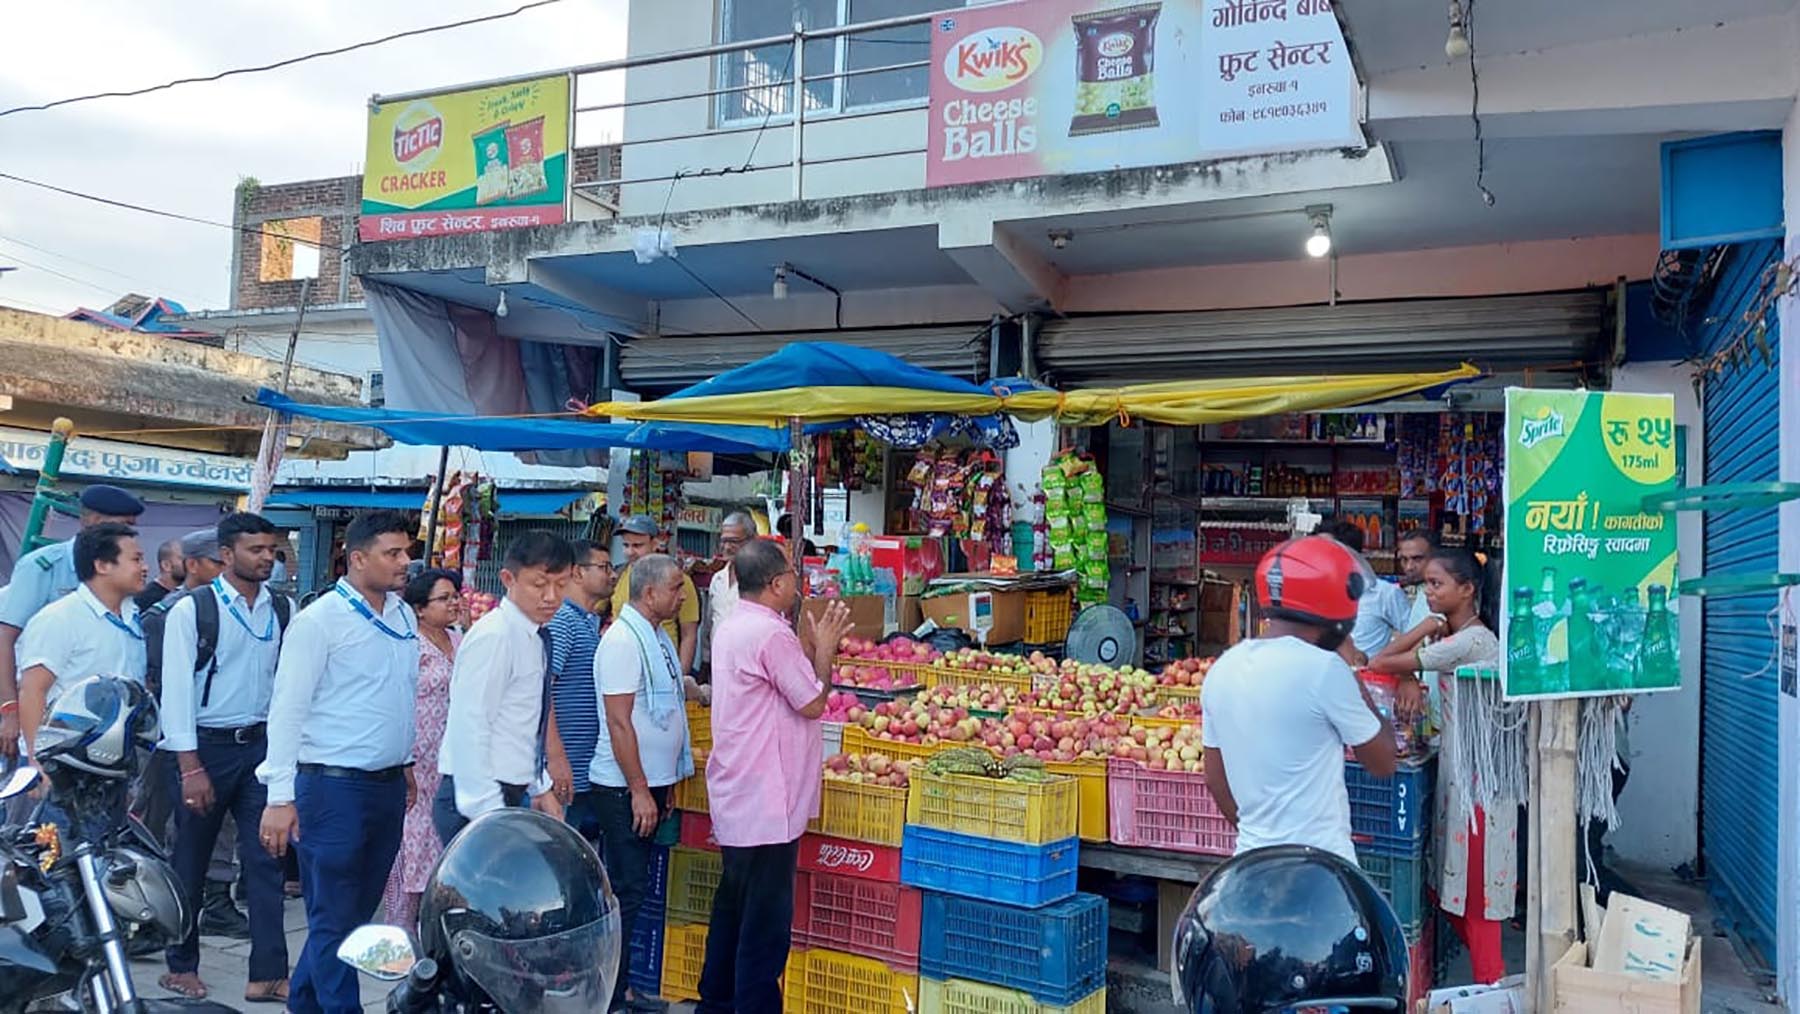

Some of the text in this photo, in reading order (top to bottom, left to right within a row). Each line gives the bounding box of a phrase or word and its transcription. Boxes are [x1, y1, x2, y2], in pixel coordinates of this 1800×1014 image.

[1268, 41, 1334, 70] सेन्टर
[1097, 64, 1133, 80] Balls
[943, 97, 1037, 126] Cheese
[942, 121, 1037, 161] Balls
[380, 171, 447, 193] CRACKER
[1522, 415, 1562, 443] Sprite
[1622, 454, 1659, 468] 175ml
[1525, 491, 1588, 531] नयाँ
[1398, 783, 1407, 831] ATC
